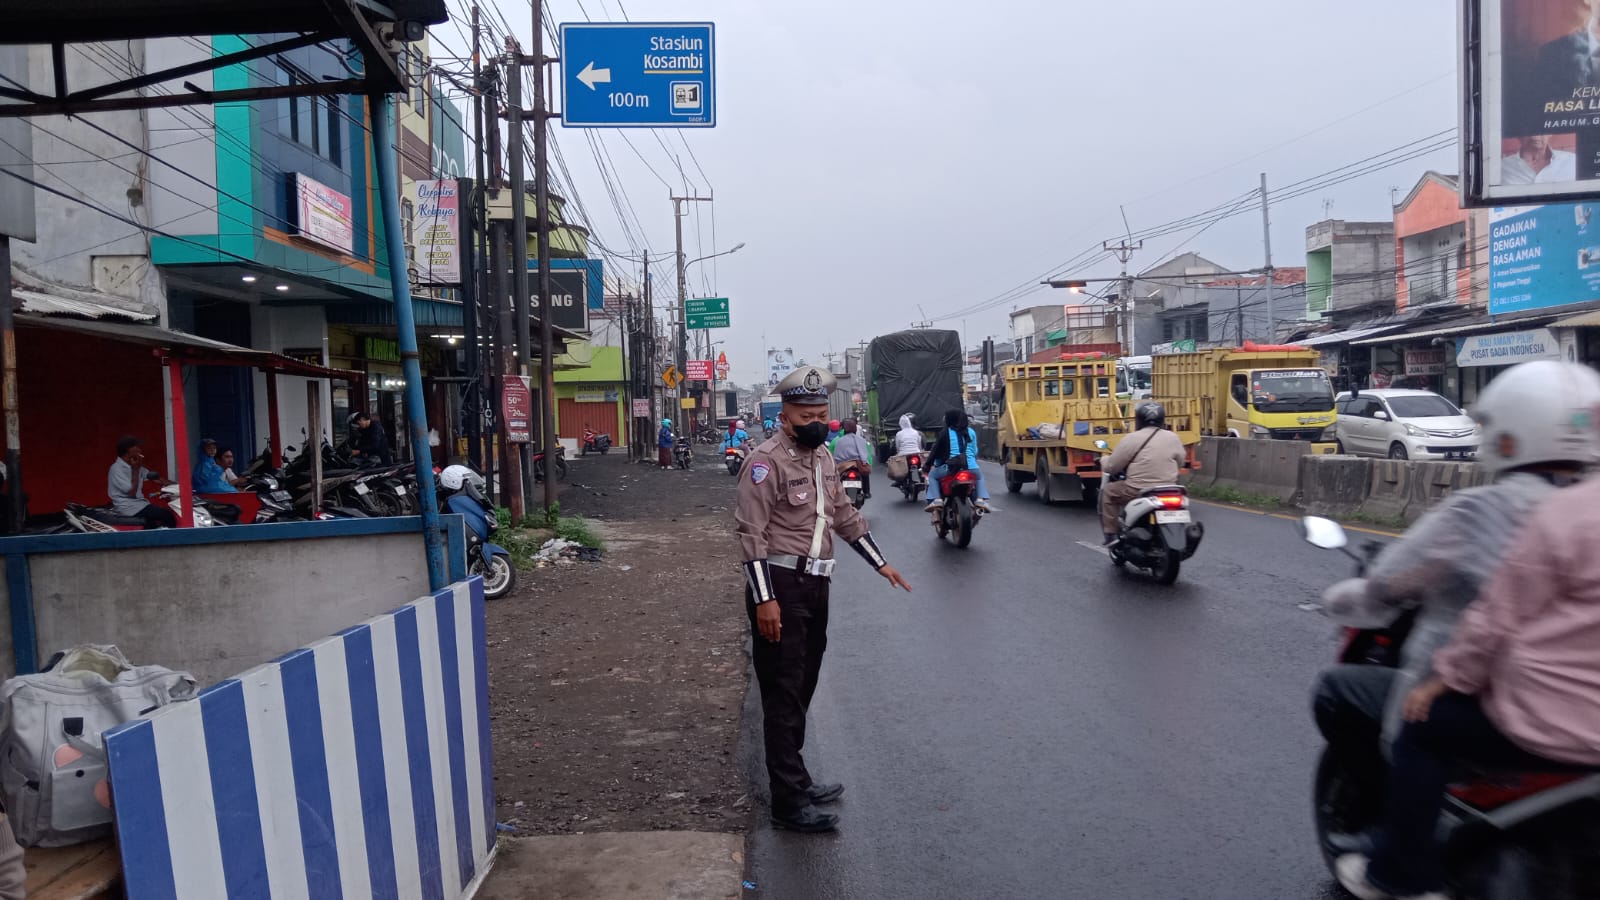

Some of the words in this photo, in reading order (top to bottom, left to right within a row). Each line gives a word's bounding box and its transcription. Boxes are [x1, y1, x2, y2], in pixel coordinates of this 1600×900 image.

[650, 36, 703, 51] Stasiun
[643, 53, 703, 69] Kosambi
[1544, 100, 1584, 113] RASA
[1493, 219, 1537, 238] GADAIKAN
[1493, 235, 1527, 252] DENGAN
[1493, 253, 1514, 266] RASA
[1515, 246, 1541, 260] AMAN
[1471, 347, 1489, 359] PUSAT
[1509, 344, 1545, 355] INDONESIA
